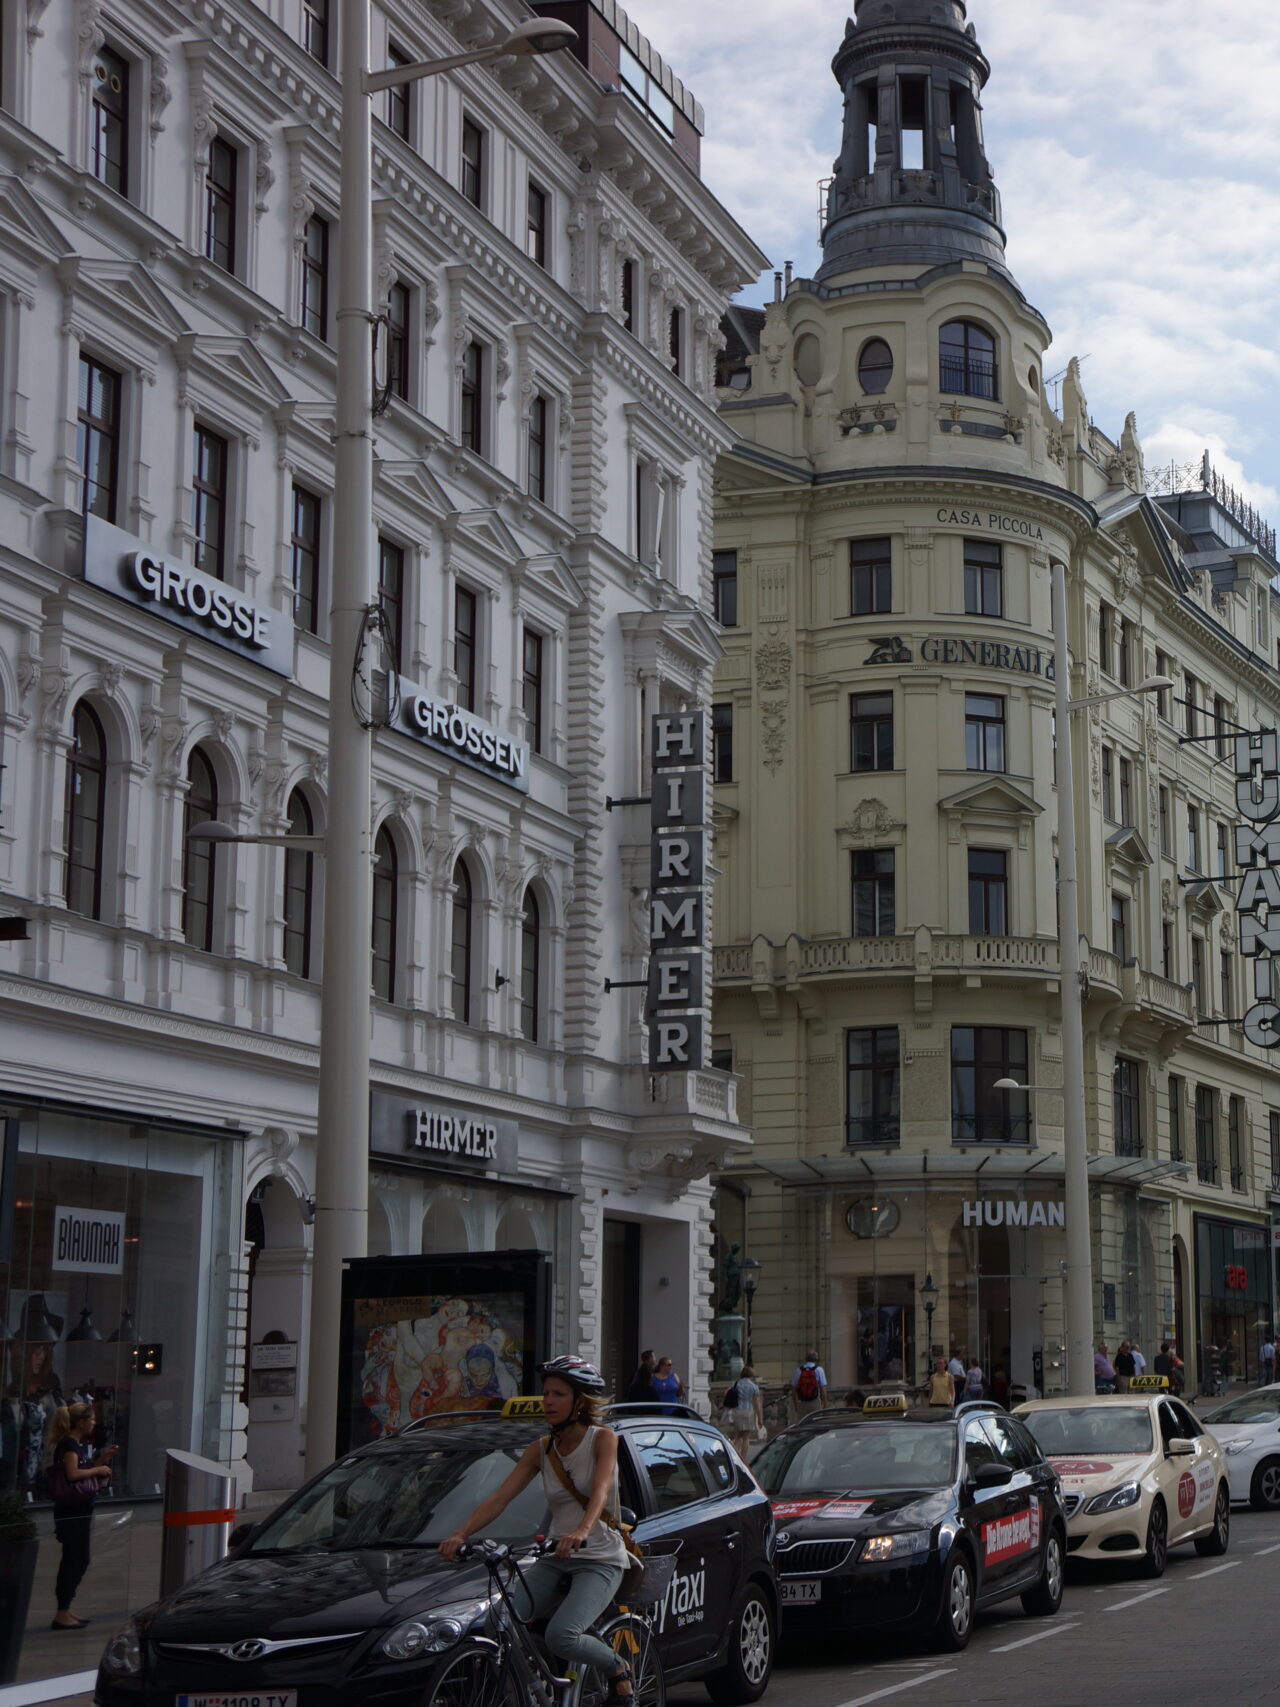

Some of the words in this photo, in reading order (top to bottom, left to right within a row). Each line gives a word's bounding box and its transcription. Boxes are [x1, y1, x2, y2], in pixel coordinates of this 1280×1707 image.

[937, 509, 981, 526] CASA
[989, 514, 1043, 540] PICCOLA
[134, 550, 271, 649] GROSSE
[921, 639, 1042, 674] GENERALI
[413, 695, 524, 776] GRÖSSEN
[651, 717, 697, 1063] HIRMER
[415, 1109, 498, 1160] HIRMER
[1226, 1264, 1249, 1290] ara
[1135, 1377, 1161, 1385] TAXI
[513, 1401, 544, 1413] TAX
[869, 1398, 899, 1408] TAXI
[986, 1524, 997, 1555] Die
[996, 1521, 1012, 1551] Krone
[646, 1557, 705, 1634] ytaxi
[801, 1584, 817, 1598] TX
